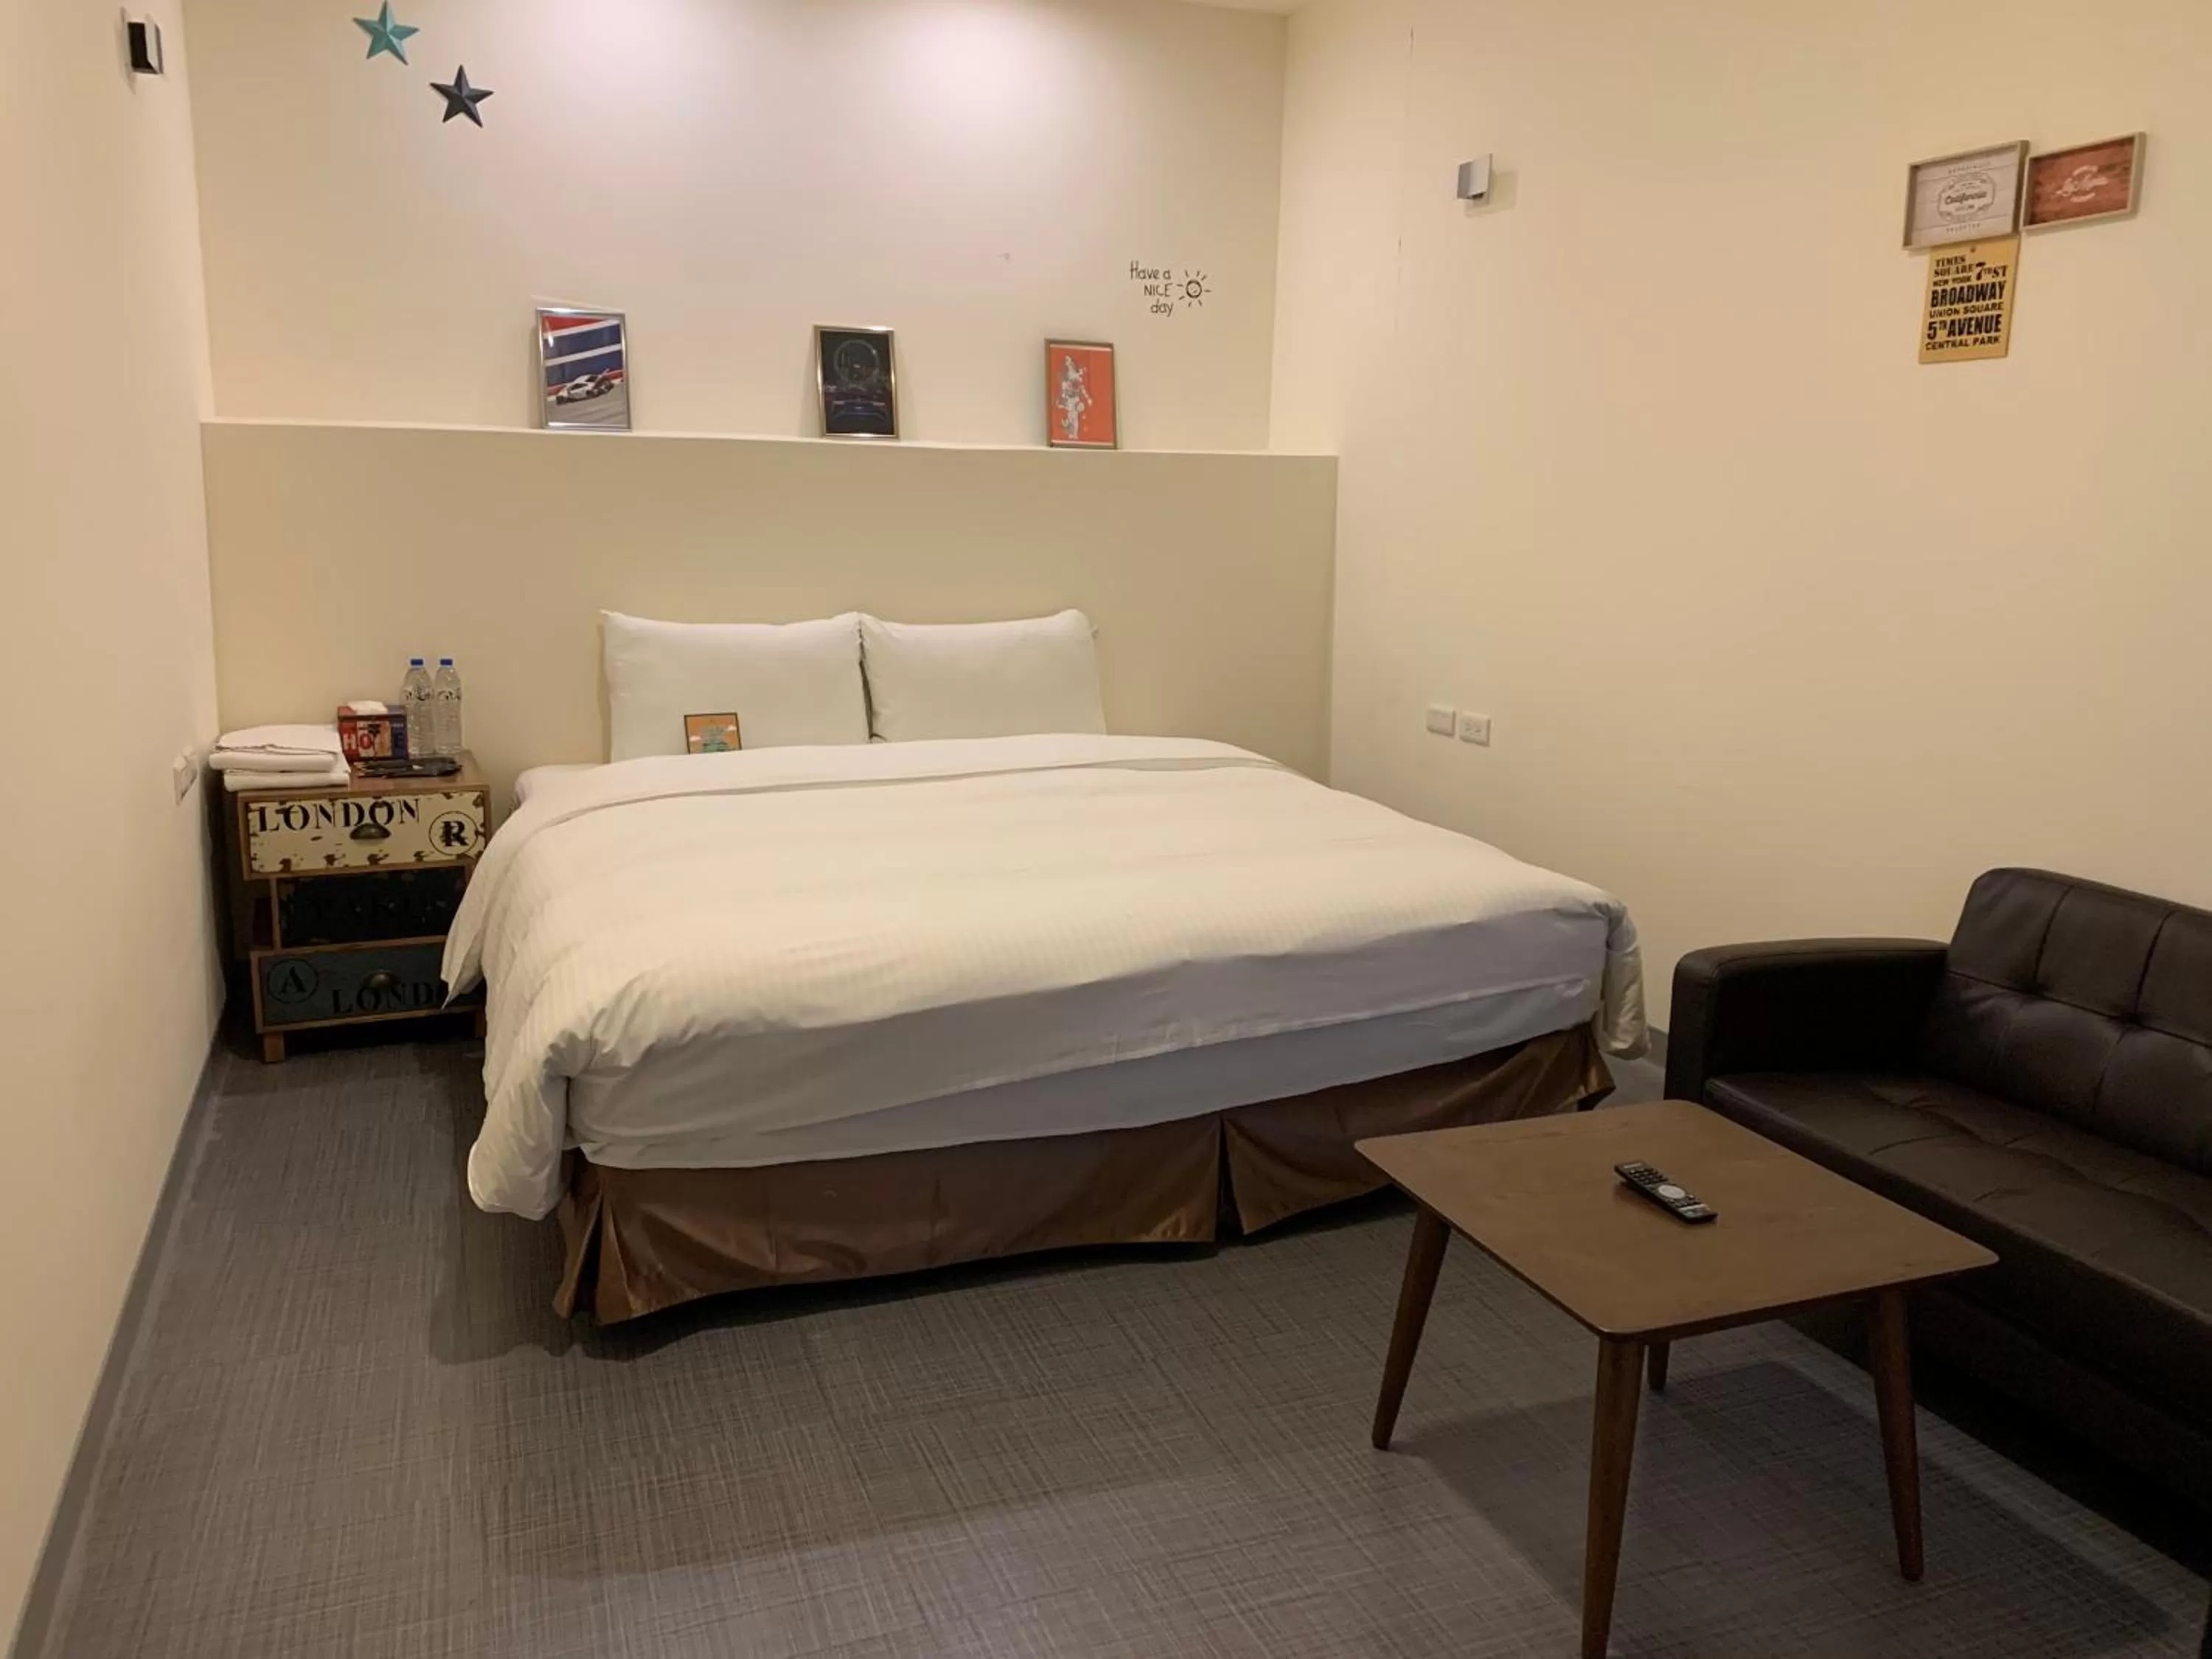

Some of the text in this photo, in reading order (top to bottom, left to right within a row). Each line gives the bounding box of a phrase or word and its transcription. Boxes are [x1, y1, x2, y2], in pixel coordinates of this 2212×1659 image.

[1130, 260, 1172, 280] Have a
[1935, 255, 1966, 268] TIMES
[1144, 282, 1173, 297] NICE
[1933, 279, 1949, 288] NEW
[1930, 280, 2006, 307] BROADWAY
[1150, 298, 1174, 317] day
[1930, 302, 2003, 318] UNION SQUARE
[1947, 314, 2003, 338] AVENUE
[1925, 336, 2000, 351] CENTRAL PARK
[258, 799, 420, 832] LONDON
[441, 820, 469, 847] R
[277, 966, 307, 995] A
